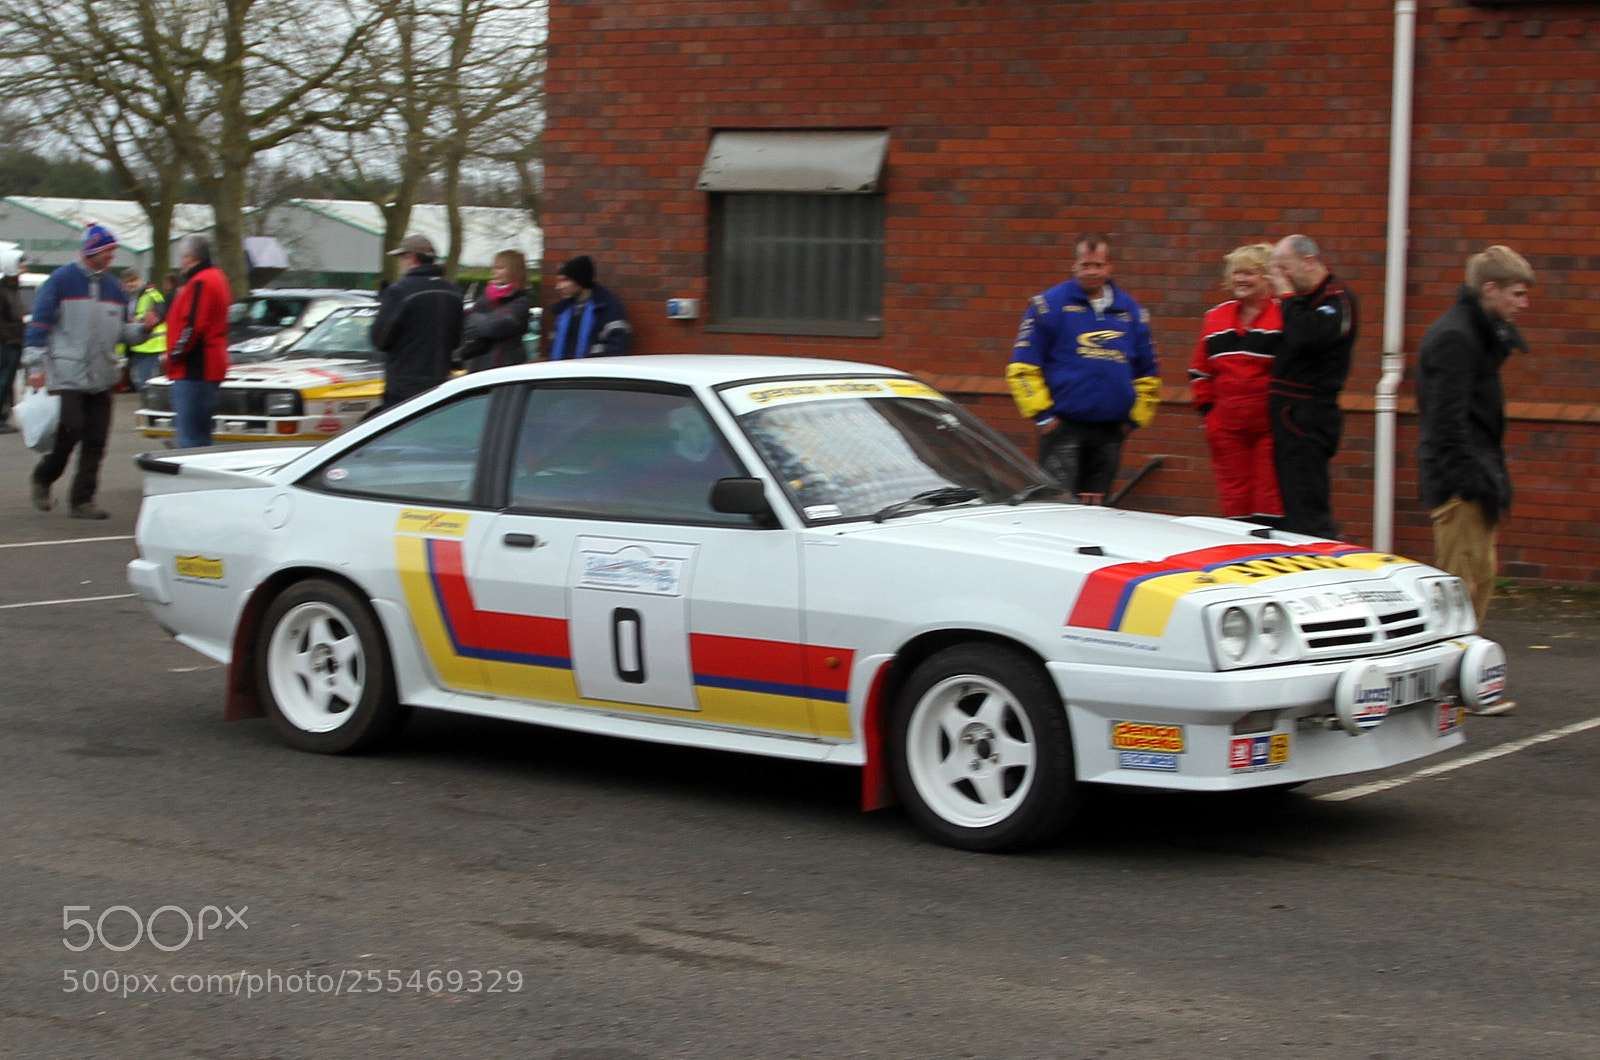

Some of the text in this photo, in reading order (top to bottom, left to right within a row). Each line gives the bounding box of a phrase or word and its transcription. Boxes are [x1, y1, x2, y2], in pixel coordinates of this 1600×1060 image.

[614, 606, 645, 684] 0
[1114, 721, 1183, 738] demon
[1112, 735, 1184, 752] tweeks
